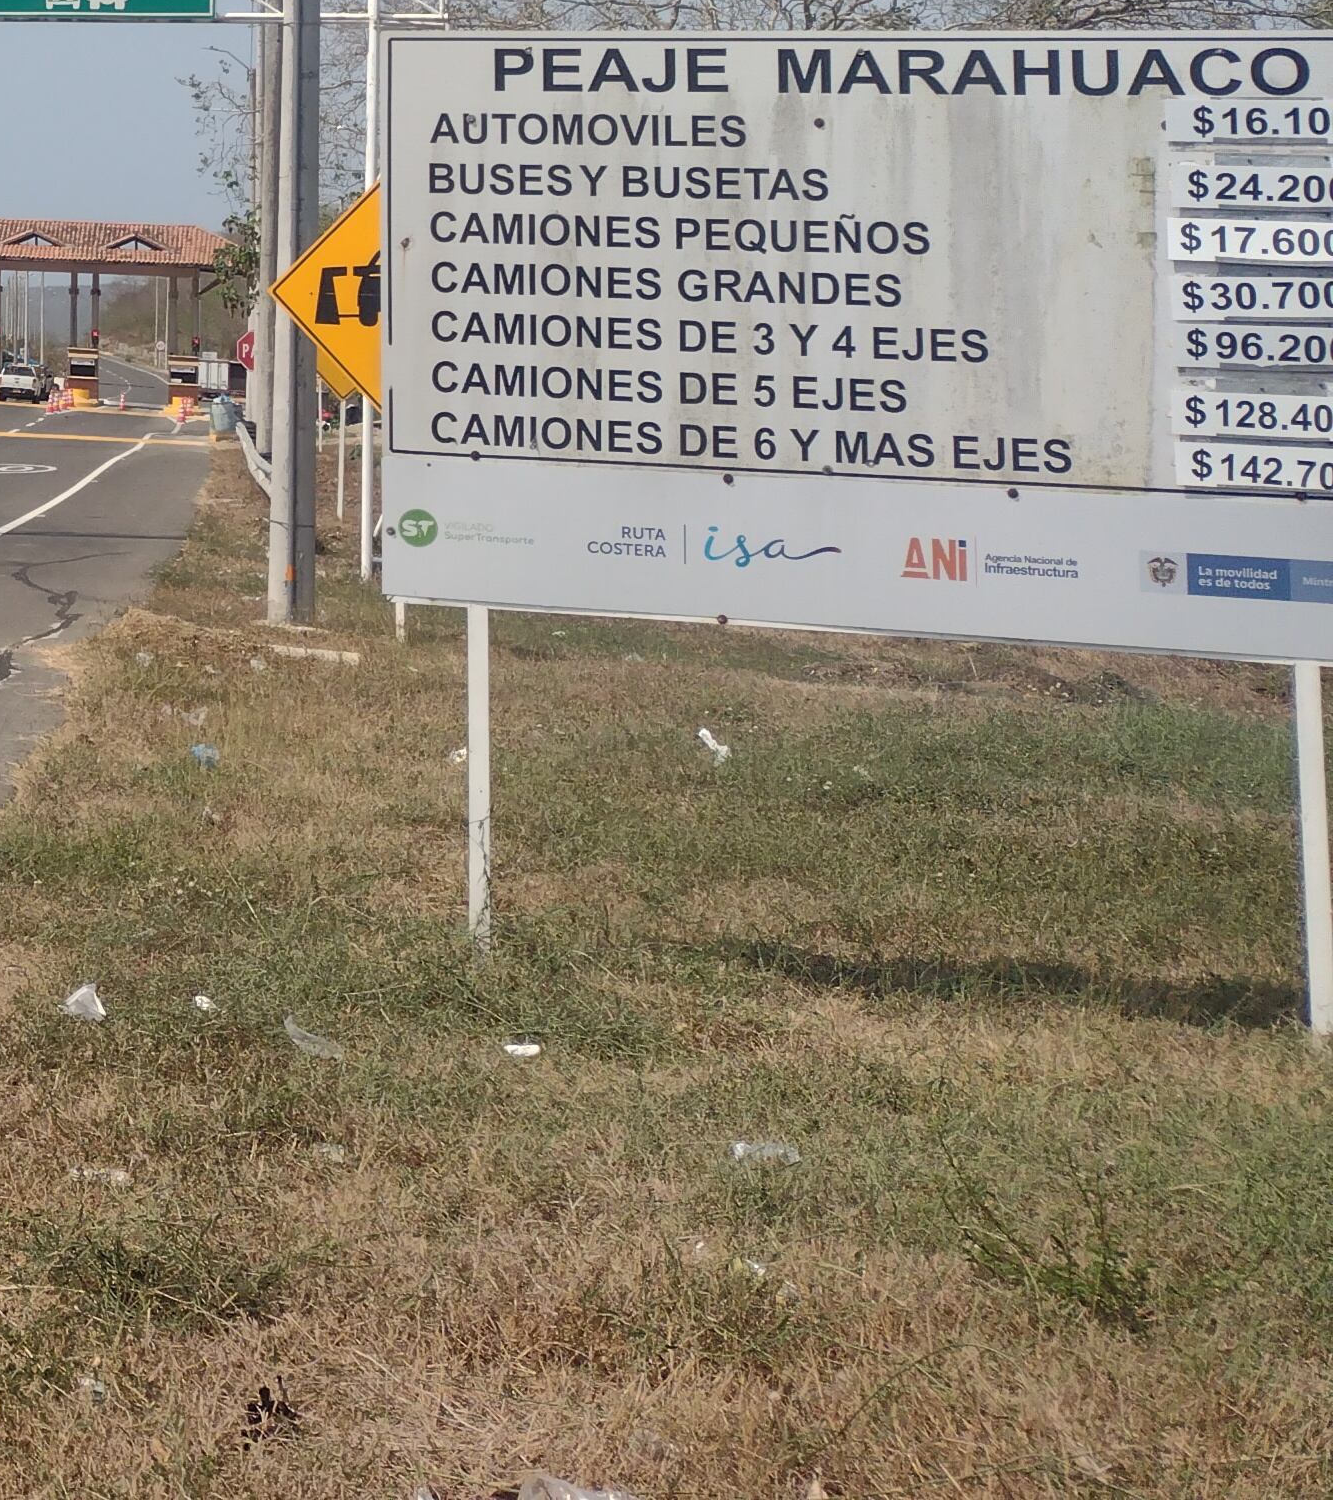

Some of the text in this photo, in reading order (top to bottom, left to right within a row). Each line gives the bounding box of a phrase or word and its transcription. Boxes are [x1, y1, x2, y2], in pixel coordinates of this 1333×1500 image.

[494, 47, 1311, 97] PEAJE MARAHUACO
[430, 113, 747, 148] AUTOMOVILES
[429, 162, 829, 202] BUSES Y BUSETAS
[1187, 169, 1333, 203] $24.20
[430, 211, 931, 255] CAMIONES PEQUEÑOS
[431, 261, 902, 308] CAMIONES GRANDES
[431, 310, 989, 364] CAMIONES DE 3 Y 4 EJES
[1186, 327, 1333, 364] $96.20
[431, 360, 907, 414] CAMIONES DE 5 EJES
[431, 411, 1073, 474] CAMIONES DE 6 Y MAS EJES
[401, 519, 435, 537] ST
[621, 526, 666, 541] RUTA
[587, 540, 667, 558] COSTERA
[704, 526, 842, 567] isa
[985, 553, 1078, 567] Agencia Nacional de
[984, 563, 1079, 579] Infraestructura
[1198, 566, 1278, 580] La movilidad
[1198, 578, 1271, 590] es de todos
